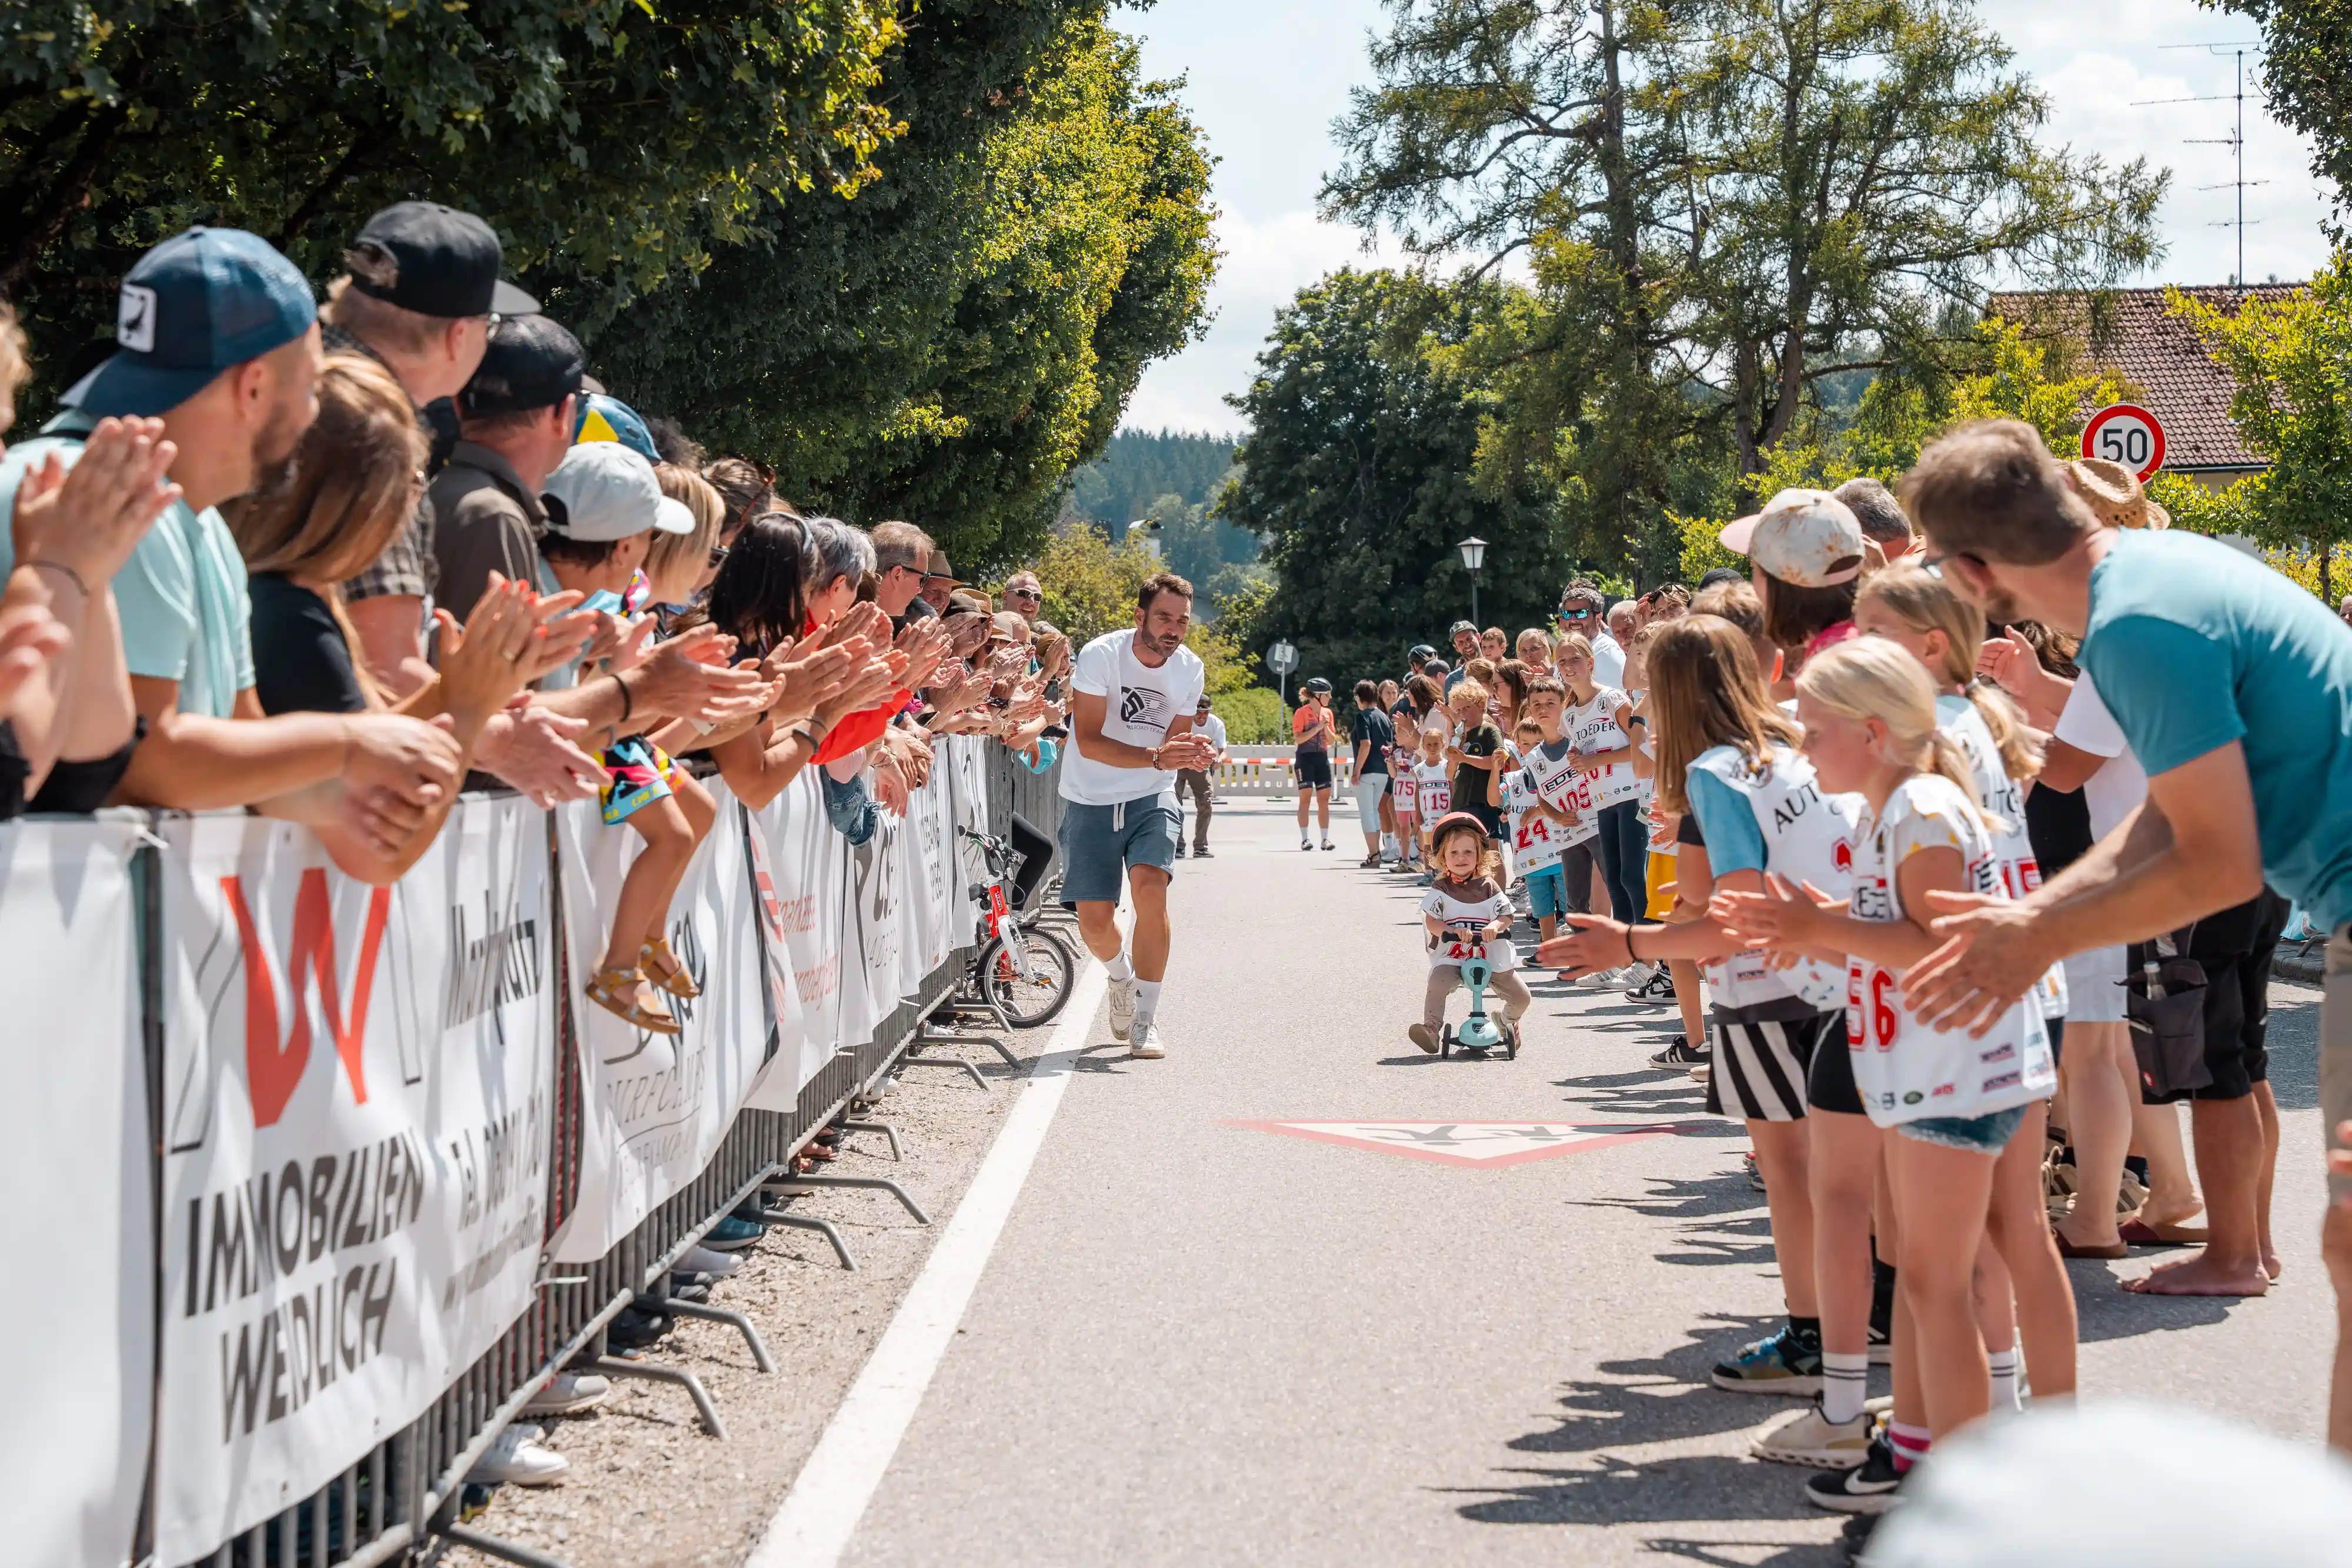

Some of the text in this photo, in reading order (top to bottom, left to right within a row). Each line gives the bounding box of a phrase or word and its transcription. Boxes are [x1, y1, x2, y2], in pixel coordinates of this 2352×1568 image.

[2103, 429, 2148, 464] 50
[1558, 781, 1592, 814] 109
[185, 1127, 425, 1318] IMMOBILIEN
[220, 1256, 396, 1445] WEDLICH
